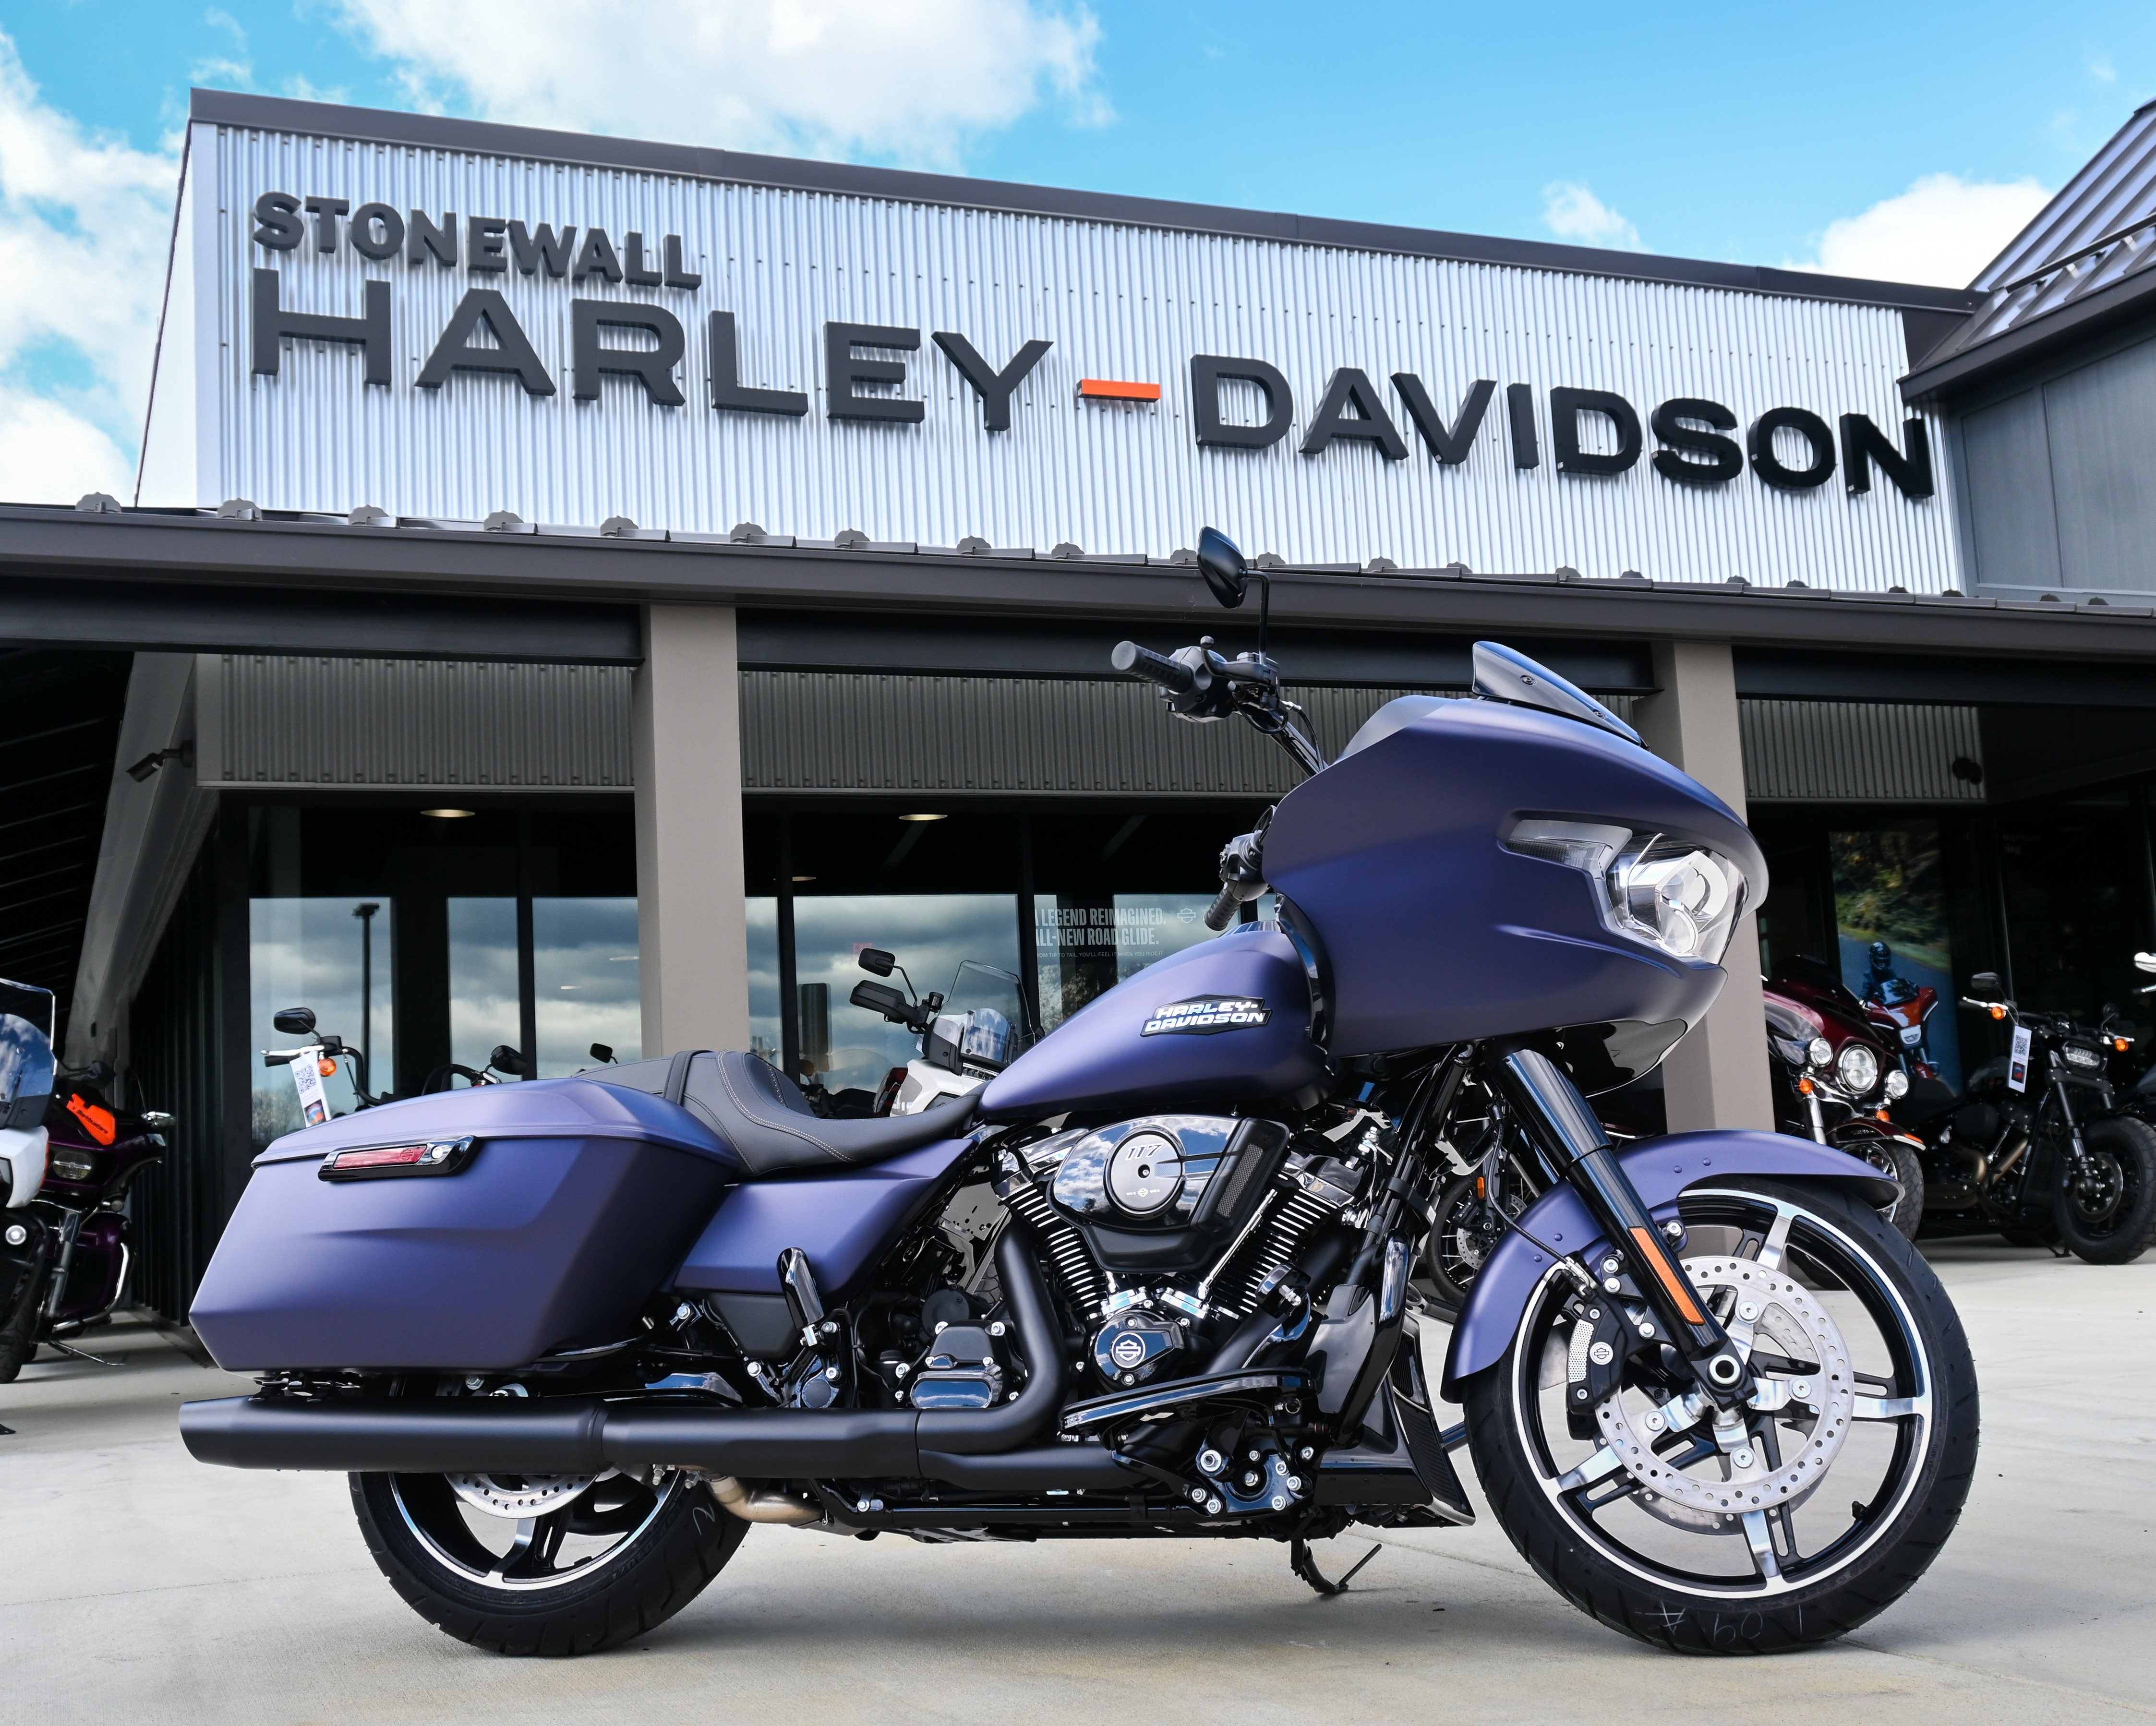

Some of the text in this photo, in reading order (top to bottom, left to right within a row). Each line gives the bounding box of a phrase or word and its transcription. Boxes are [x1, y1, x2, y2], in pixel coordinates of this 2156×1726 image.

[252, 191, 701, 289] STONEWALL
[1041, 909, 1087, 926] LEGEND
[1090, 908, 1167, 926] REIMAGINED.
[1087, 928, 1119, 946] ROAD
[1121, 928, 1159, 946] GLIDE.
[1156, 1001, 1258, 1019] HARLEY-
[1144, 1012, 1266, 1032] DAVIDSON
[1125, 1142, 1165, 1161] 117
